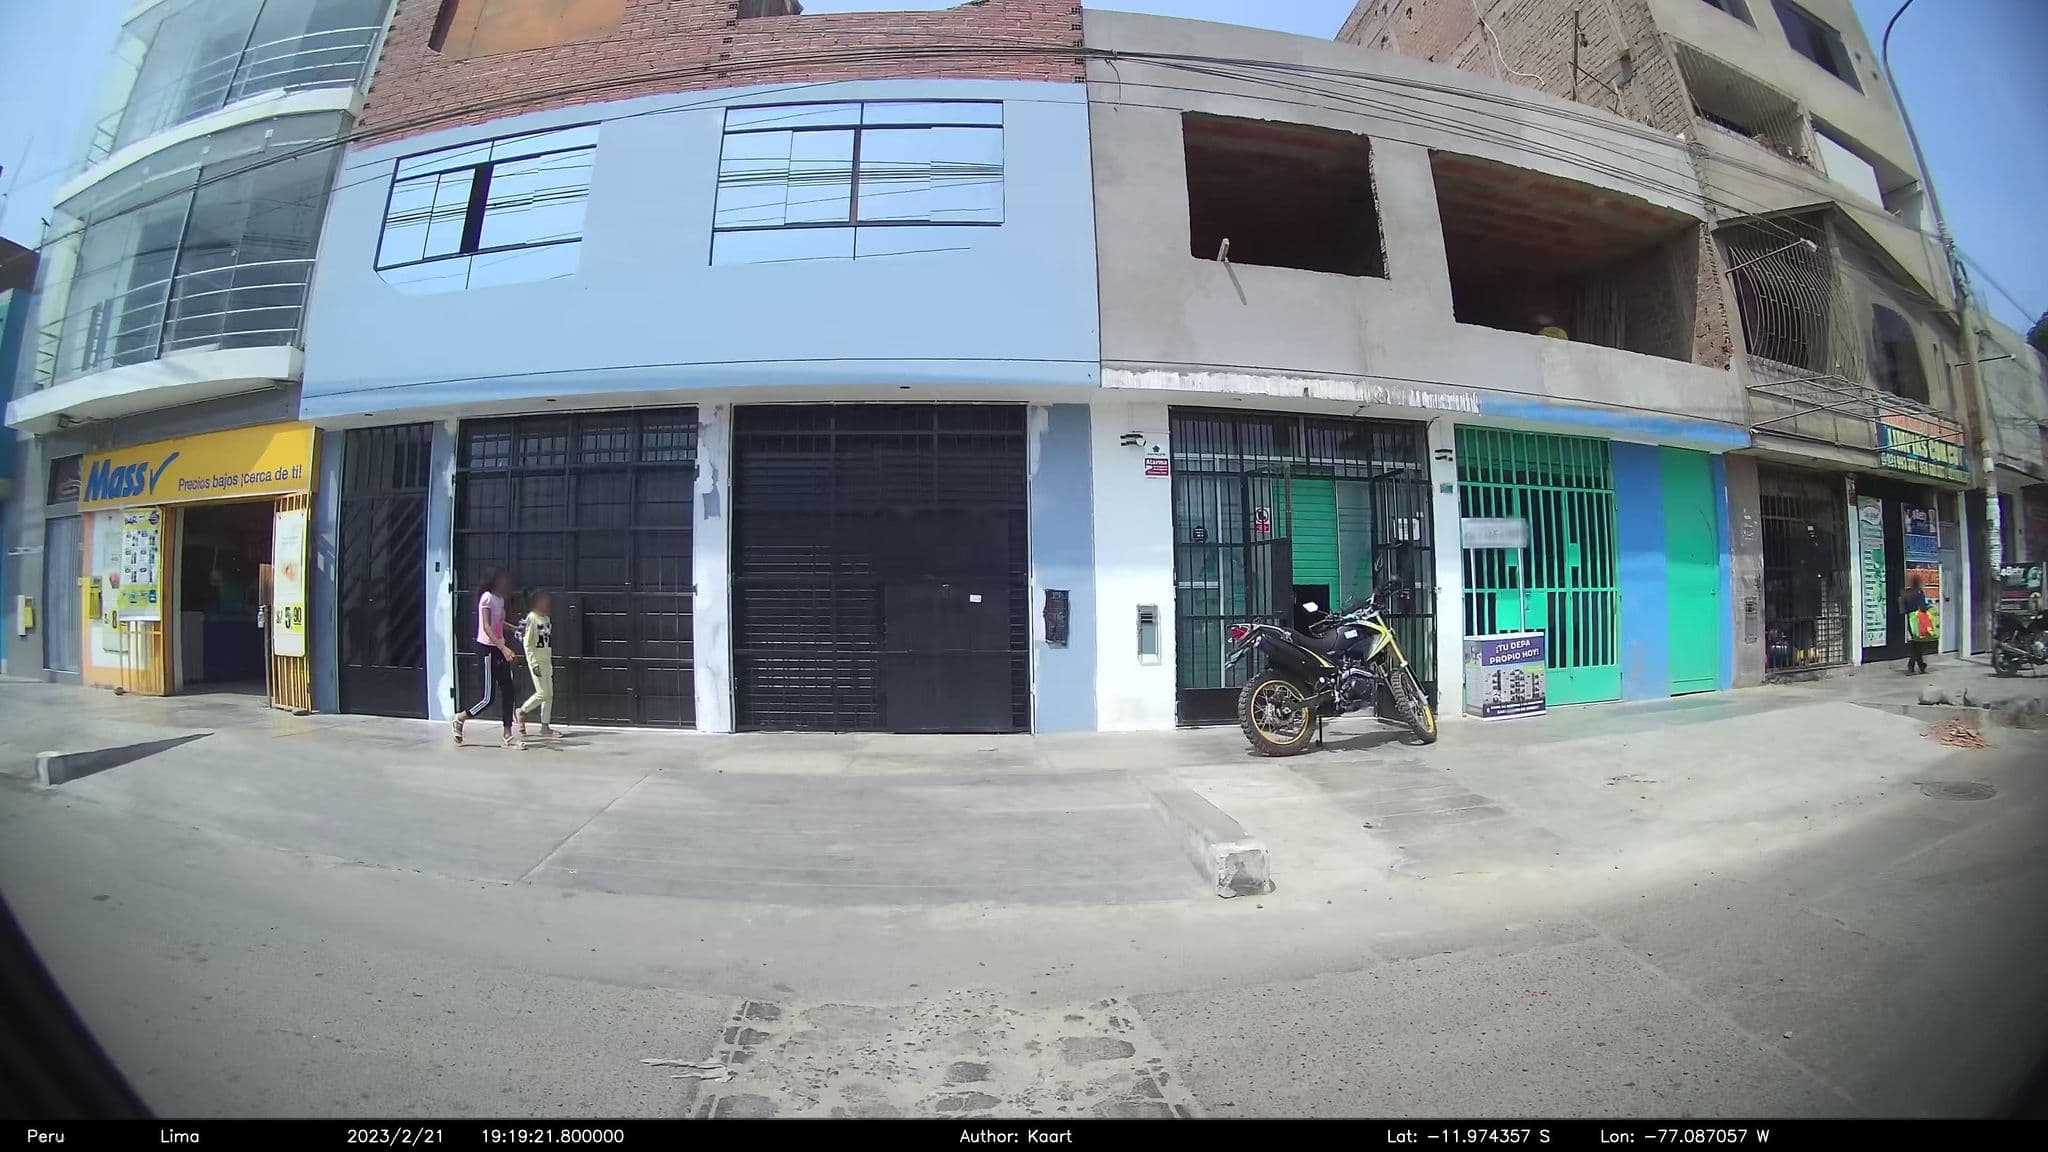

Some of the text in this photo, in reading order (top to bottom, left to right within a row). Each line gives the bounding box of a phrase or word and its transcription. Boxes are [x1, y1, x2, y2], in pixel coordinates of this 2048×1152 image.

[83, 459, 148, 502] Mass
[178, 478, 210, 492] Precios
[212, 473, 238, 491] bajos
[275, 467, 289, 481] de
[292, 464, 302, 479] ti!
[1489, 648, 1540, 665] PROPIO HOY!
[1495, 639, 1531, 654] ¡TU DEPA
